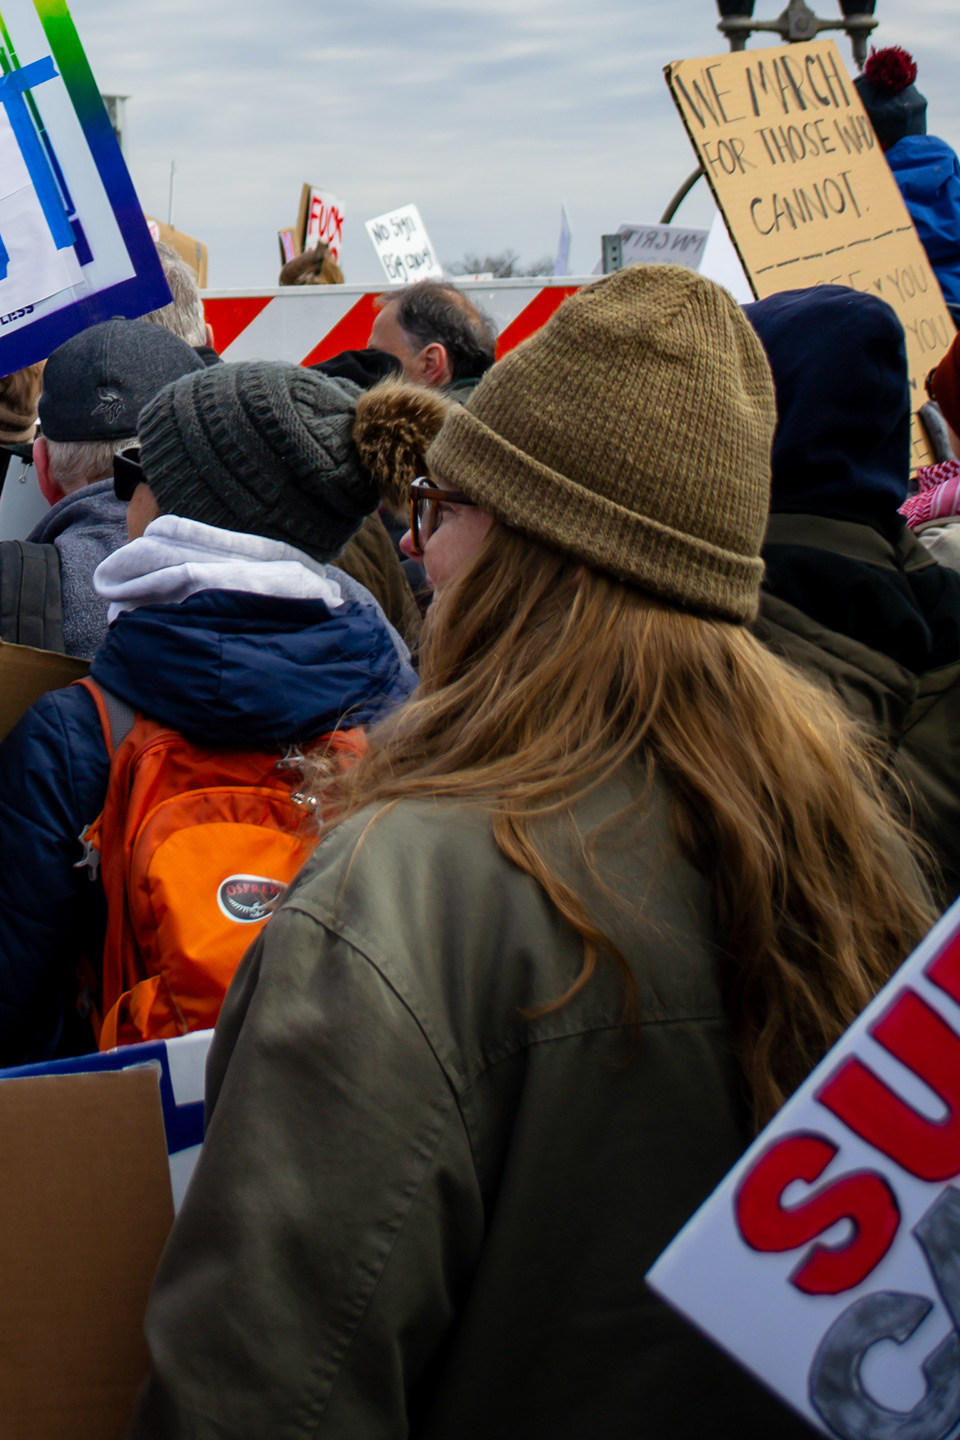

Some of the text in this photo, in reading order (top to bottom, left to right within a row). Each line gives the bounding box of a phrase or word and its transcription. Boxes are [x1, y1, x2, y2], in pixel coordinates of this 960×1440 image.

[674, 50, 851, 129] WE MARCH
[702, 114, 875, 178] FOR THOSE WHO
[308, 195, 344, 243] FUCK
[732, 922, 960, 1297] SU
